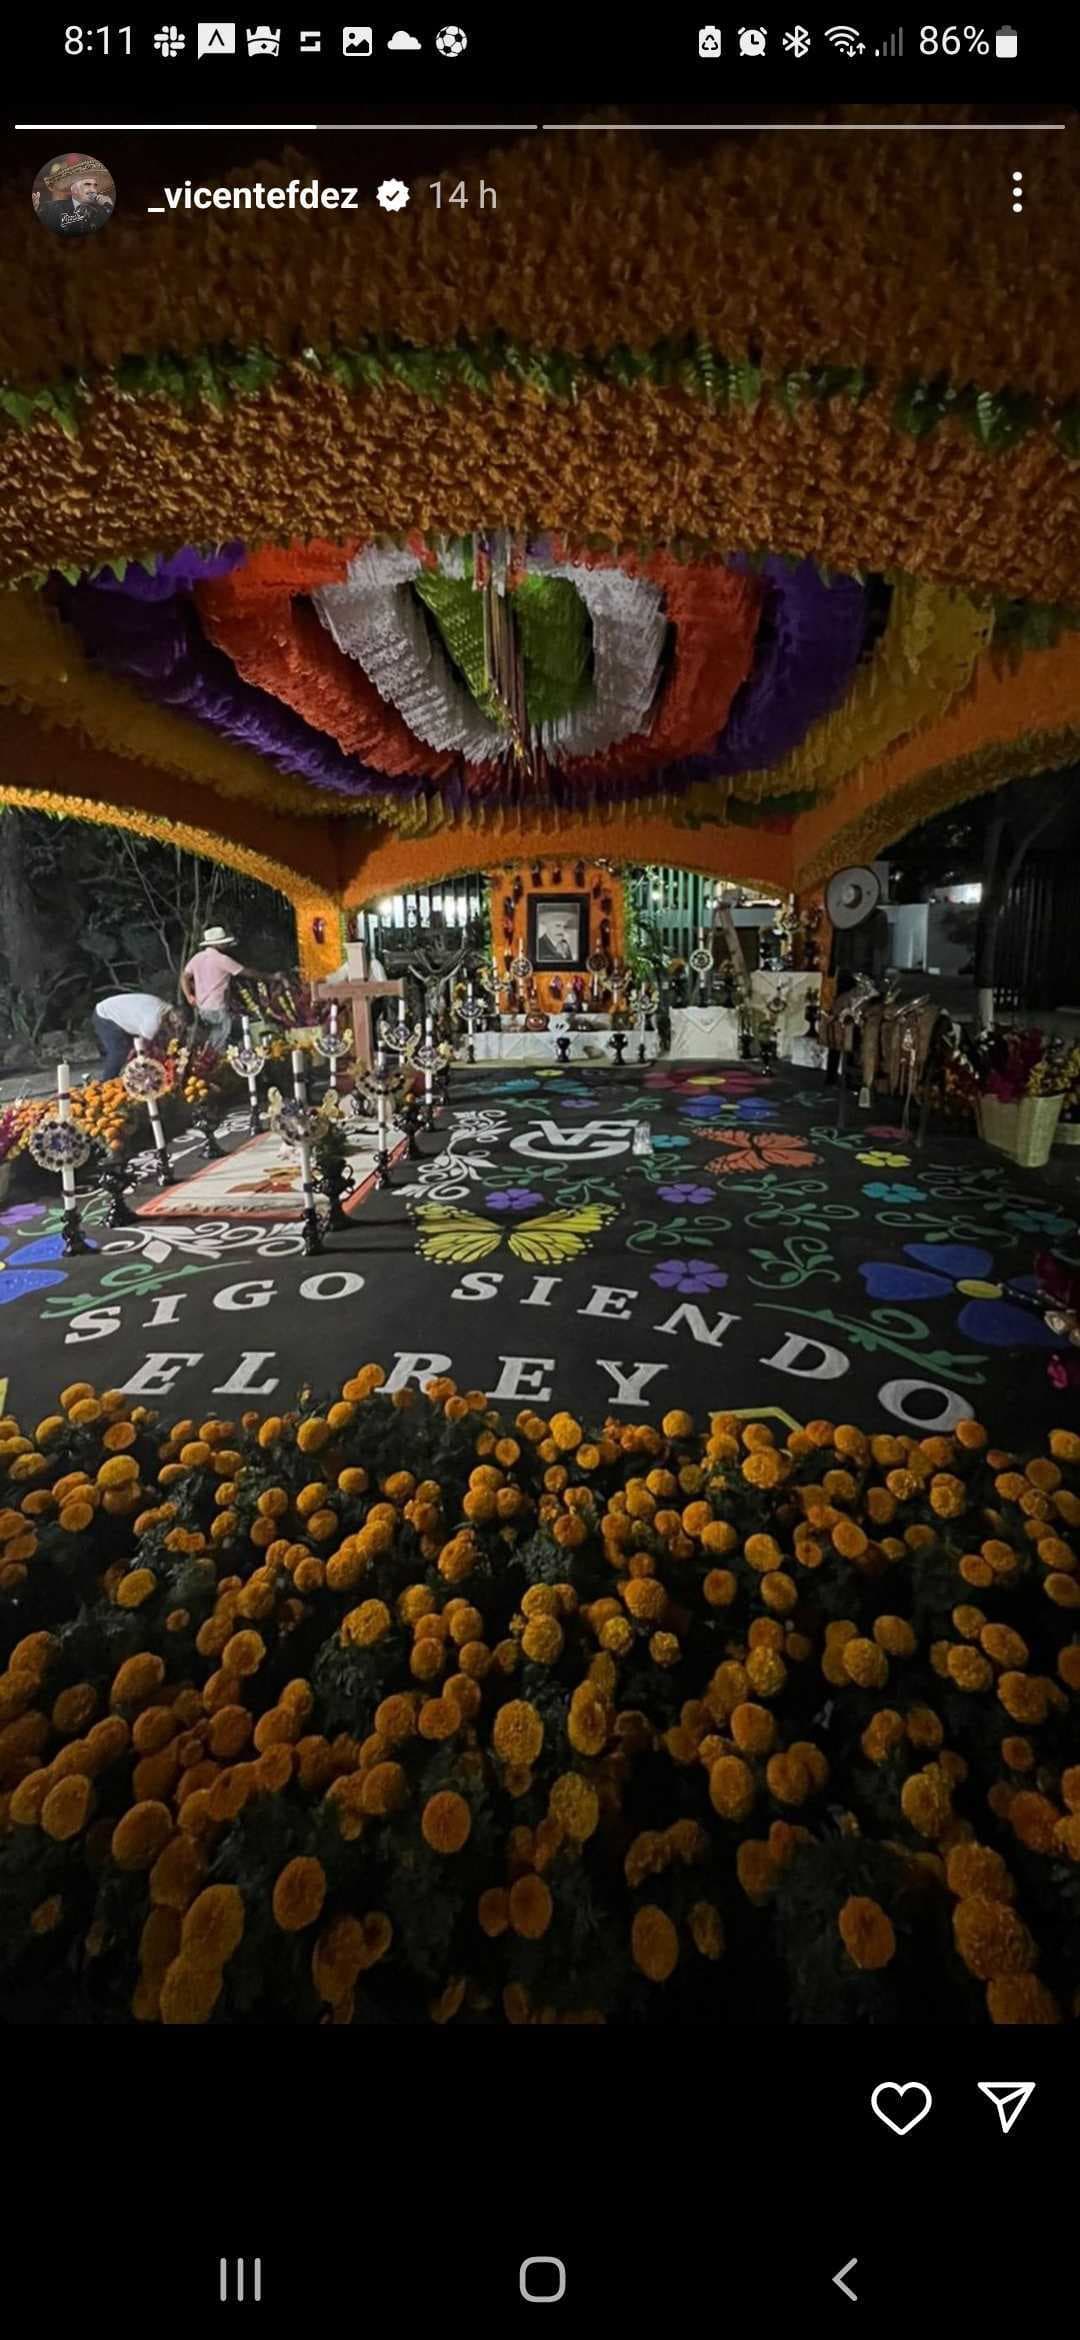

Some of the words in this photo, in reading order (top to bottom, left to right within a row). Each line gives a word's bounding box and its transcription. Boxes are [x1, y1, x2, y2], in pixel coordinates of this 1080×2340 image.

[64, 1271, 366, 1344] SIGO
[450, 1271, 976, 1433] SIENDO
[117, 1351, 281, 1396] EL
[375, 1351, 669, 1408] REY
